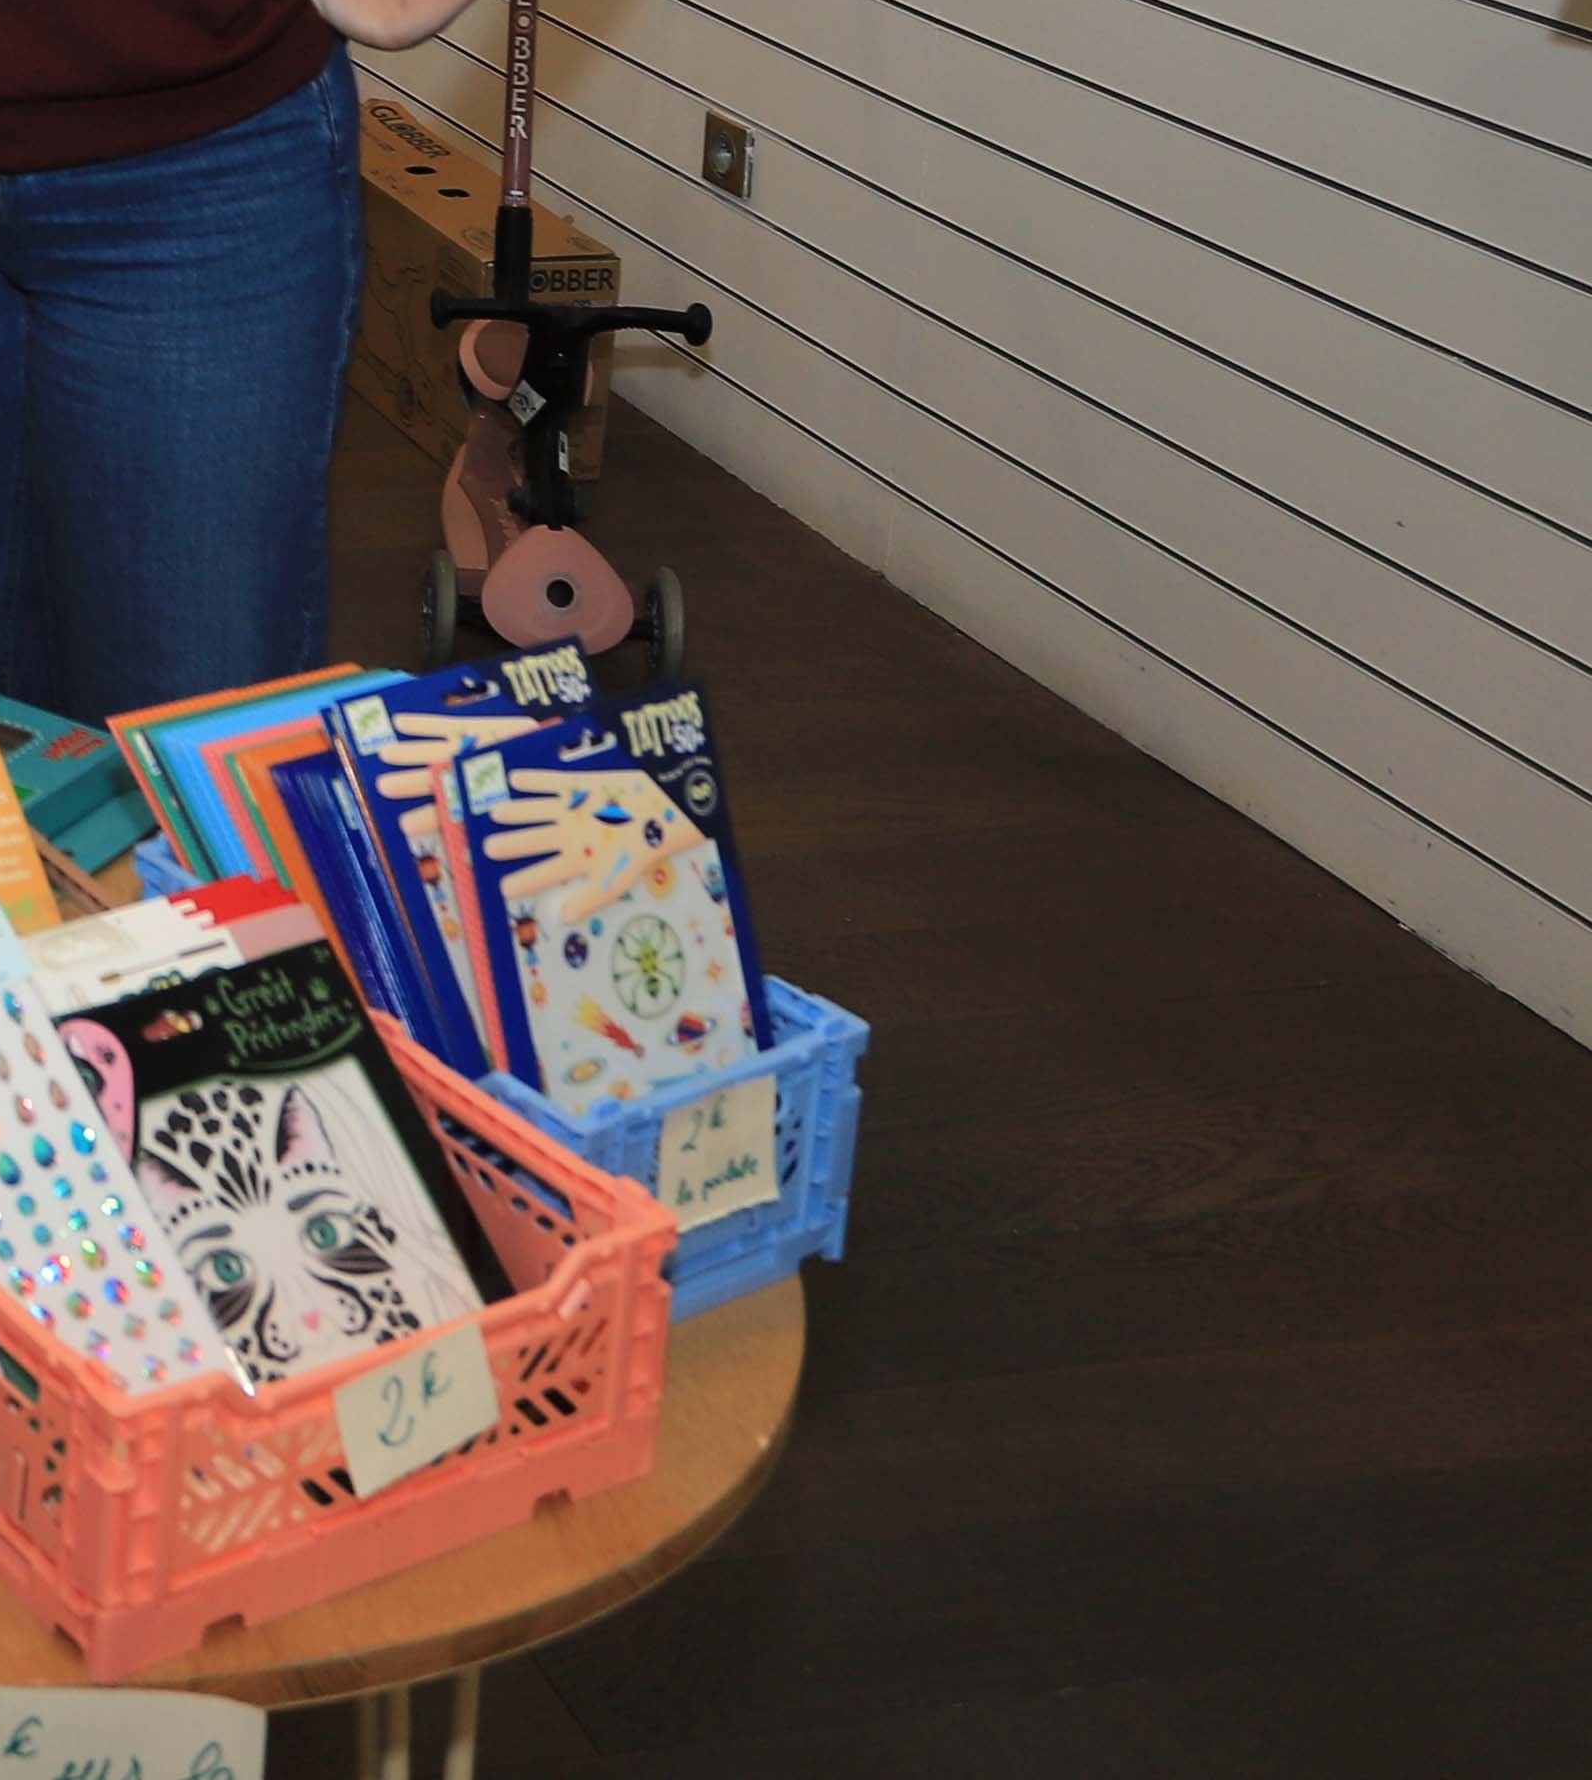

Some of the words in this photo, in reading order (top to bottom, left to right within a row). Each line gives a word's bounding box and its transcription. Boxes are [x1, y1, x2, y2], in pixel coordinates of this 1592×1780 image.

[369, 104, 451, 159] GLOBBER
[529, 268, 615, 293] OBBER
[217, 968, 296, 1018] Great
